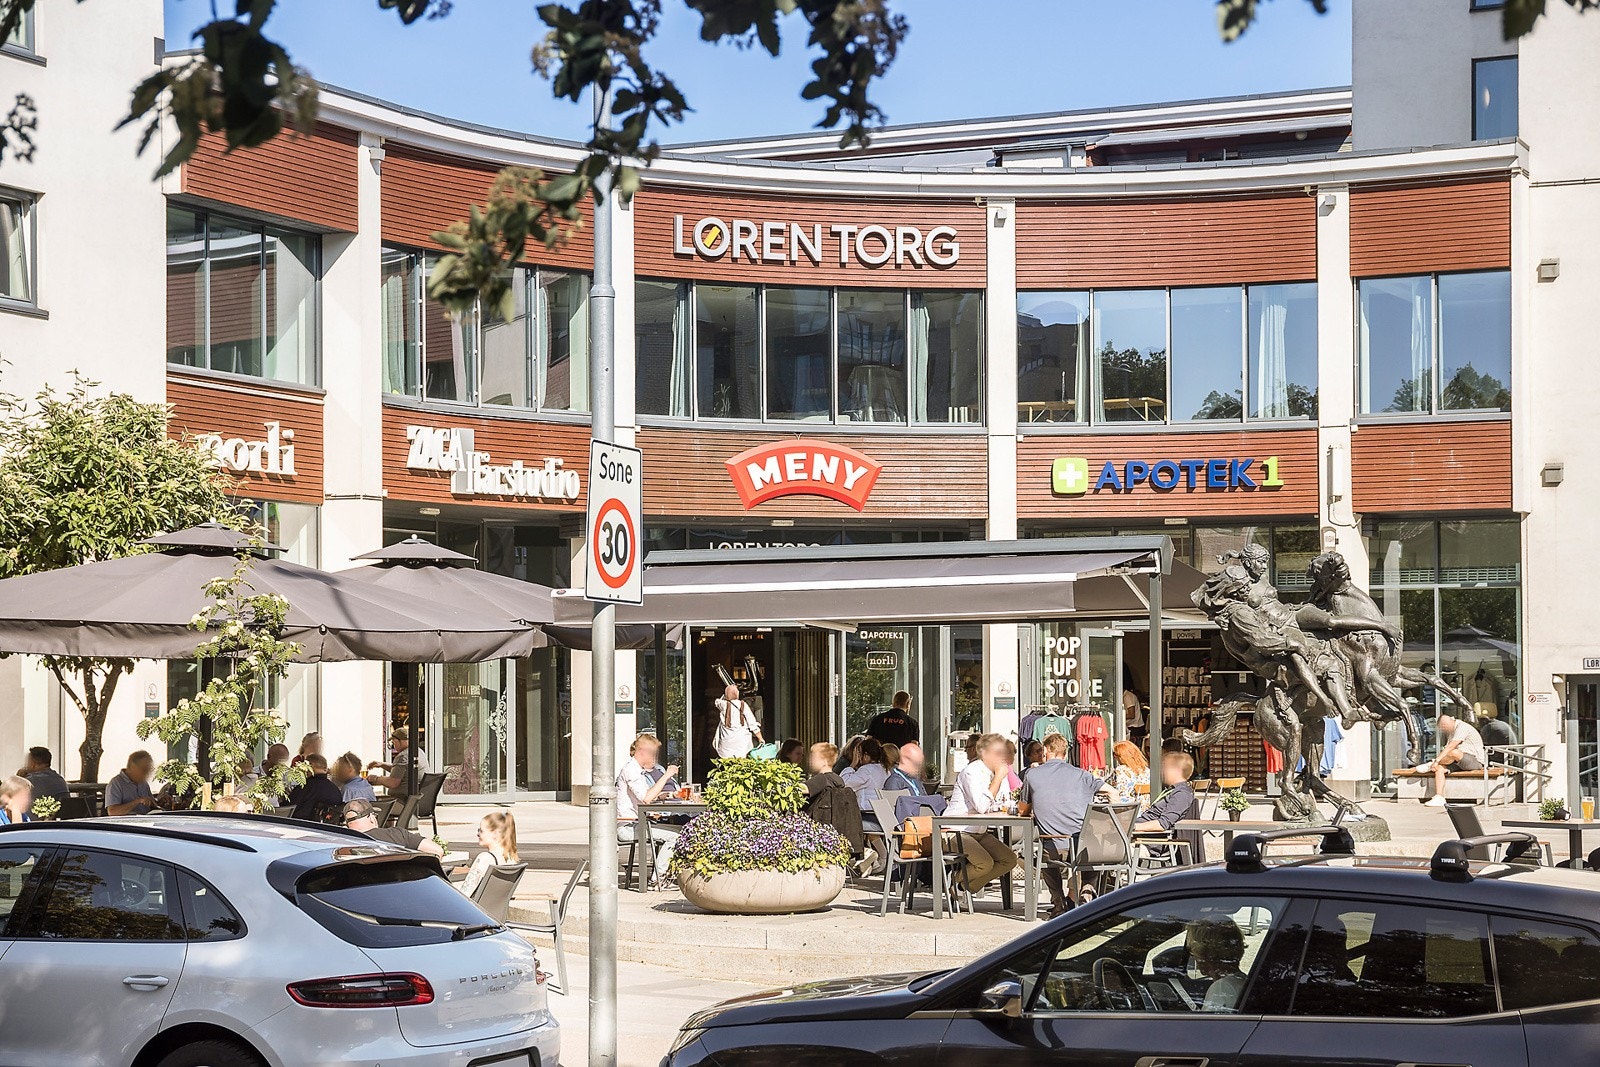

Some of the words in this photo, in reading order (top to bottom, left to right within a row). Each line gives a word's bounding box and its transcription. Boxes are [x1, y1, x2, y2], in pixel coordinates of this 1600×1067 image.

[673, 214, 823, 263] LØREN
[830, 224, 960, 266] TORG
[599, 452, 633, 484] Sone
[746, 452, 869, 492] MENY
[601, 521, 628, 566] 30
[869, 655, 894, 665] norli
[1044, 636, 1081, 655] POP
[1044, 657, 1078, 676] -UP
